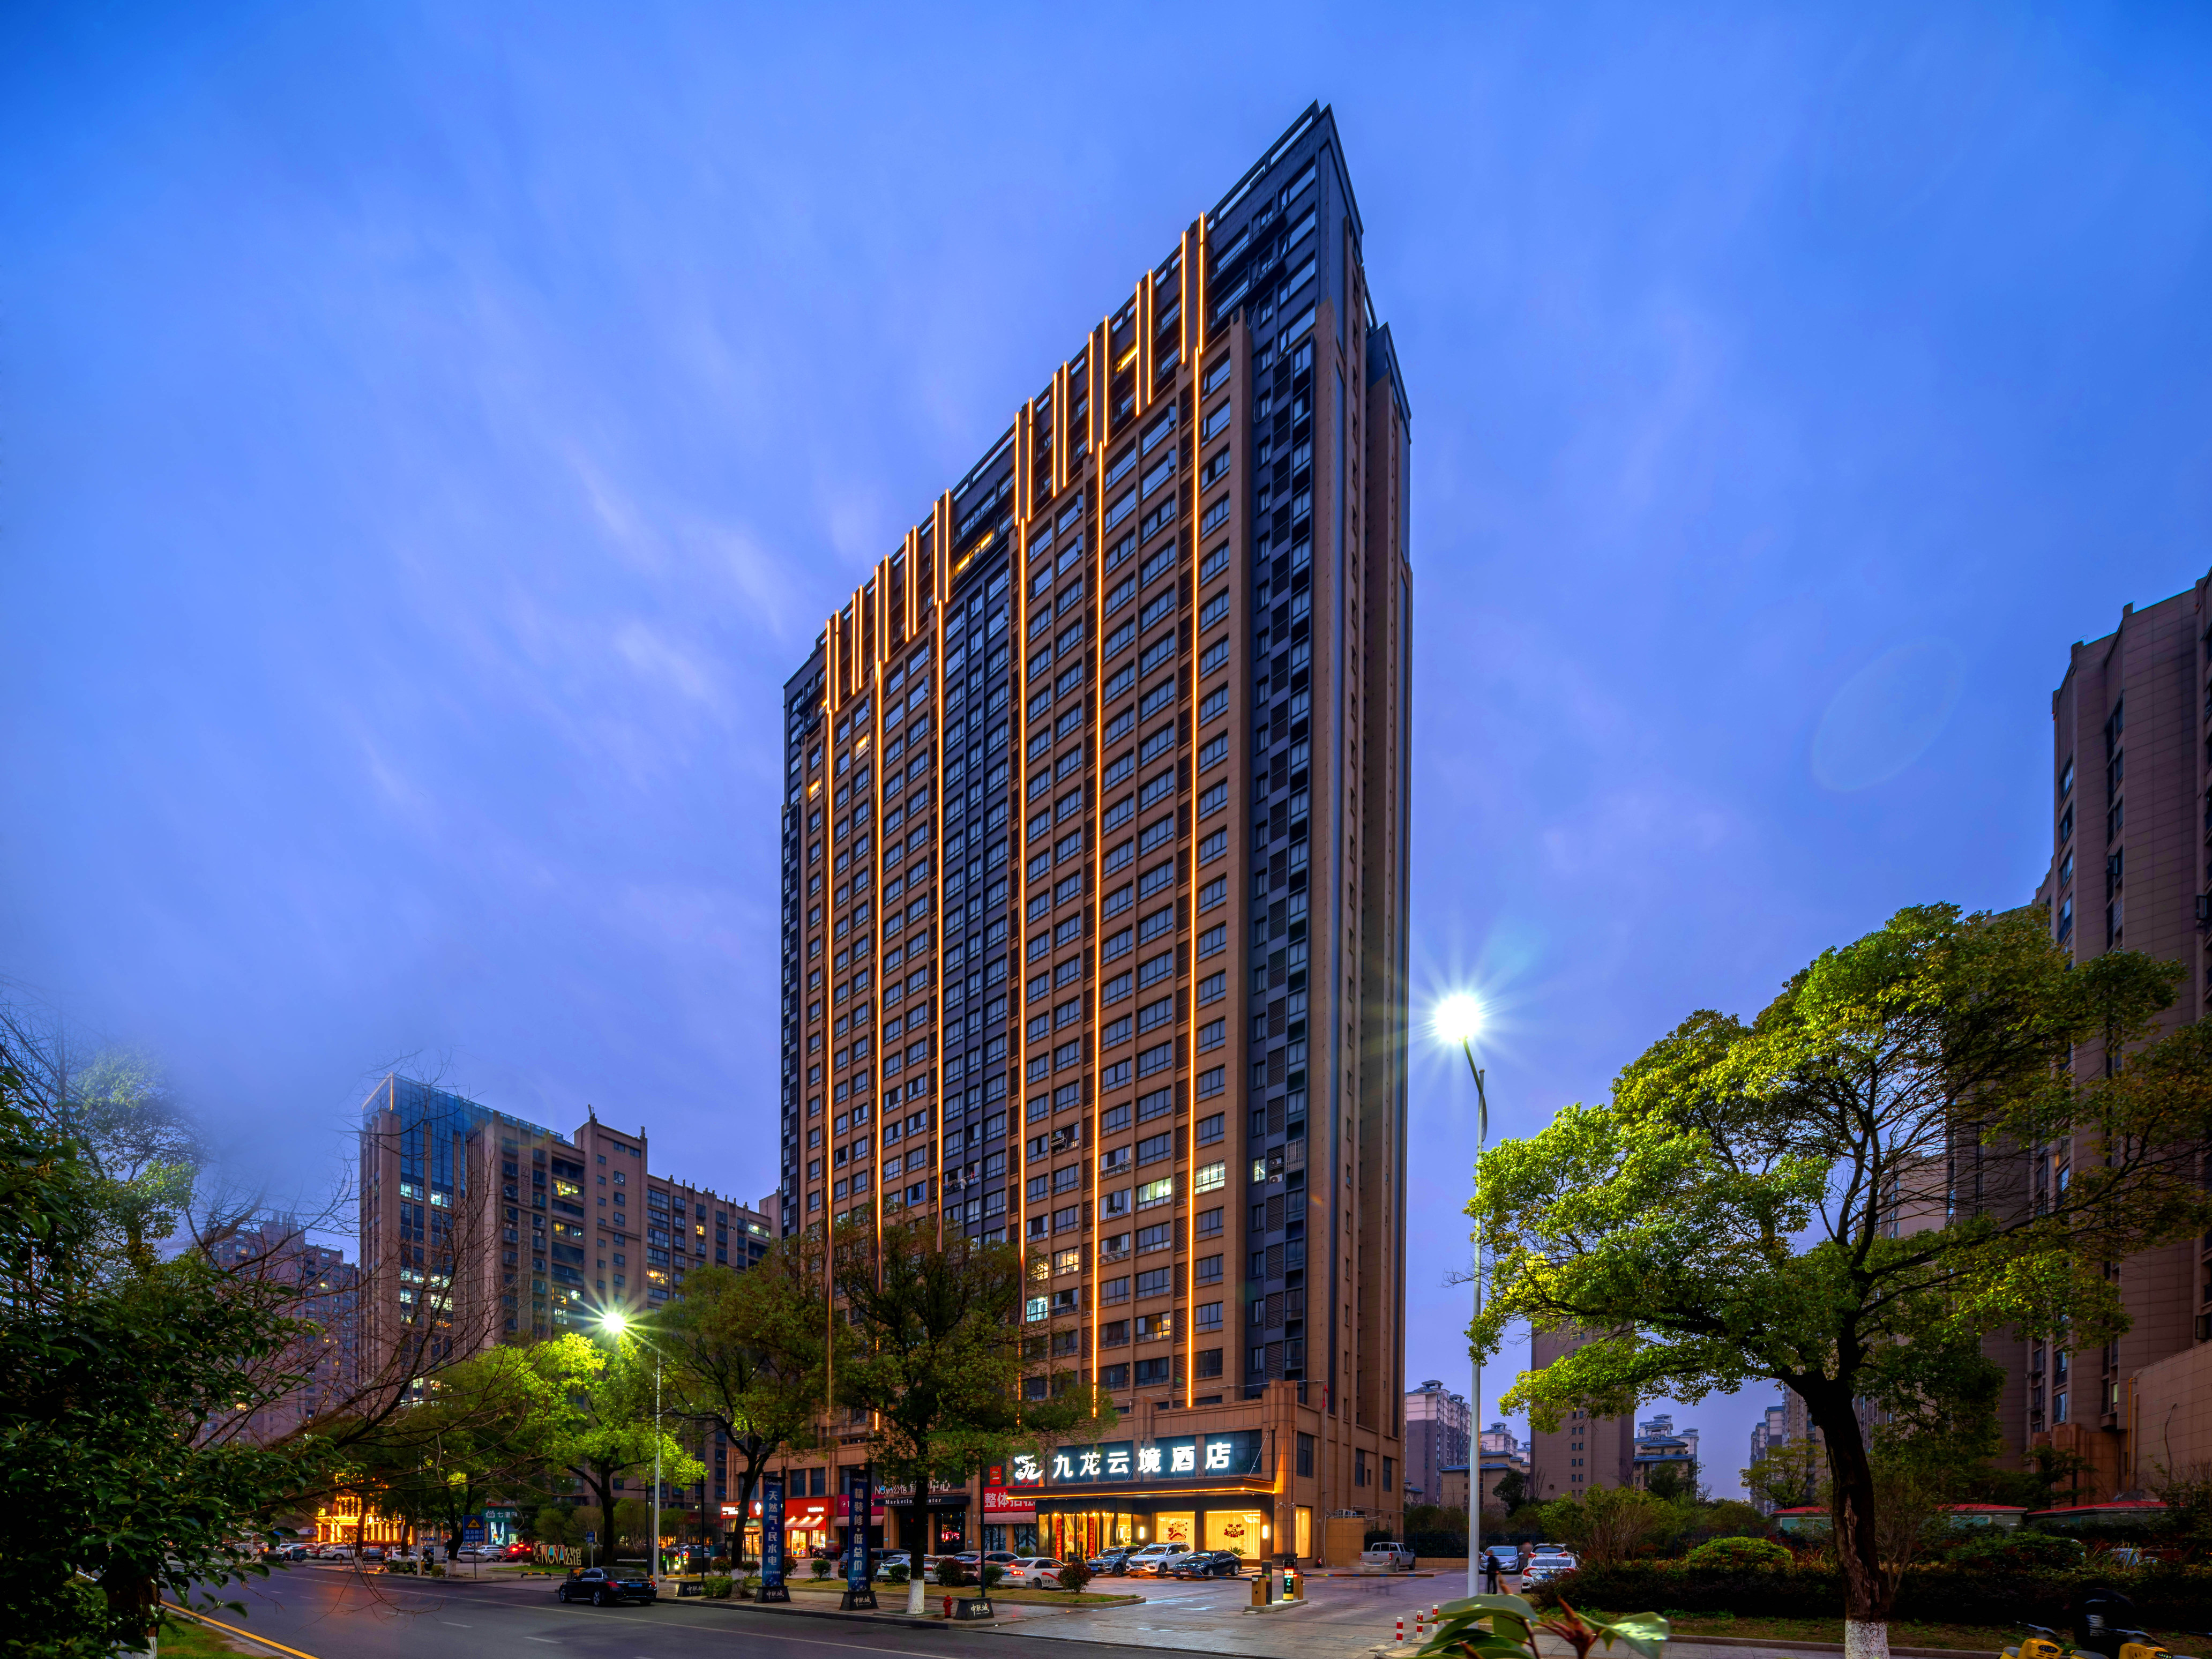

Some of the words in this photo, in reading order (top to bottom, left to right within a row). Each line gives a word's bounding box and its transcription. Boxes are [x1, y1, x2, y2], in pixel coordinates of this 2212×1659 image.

[1053, 1443, 1231, 1479] 九龙云境酒店
[766, 1590, 784, 1600] 中联城
[854, 1595, 872, 1607] 中联城
[970, 1602, 990, 1617] 中联城
